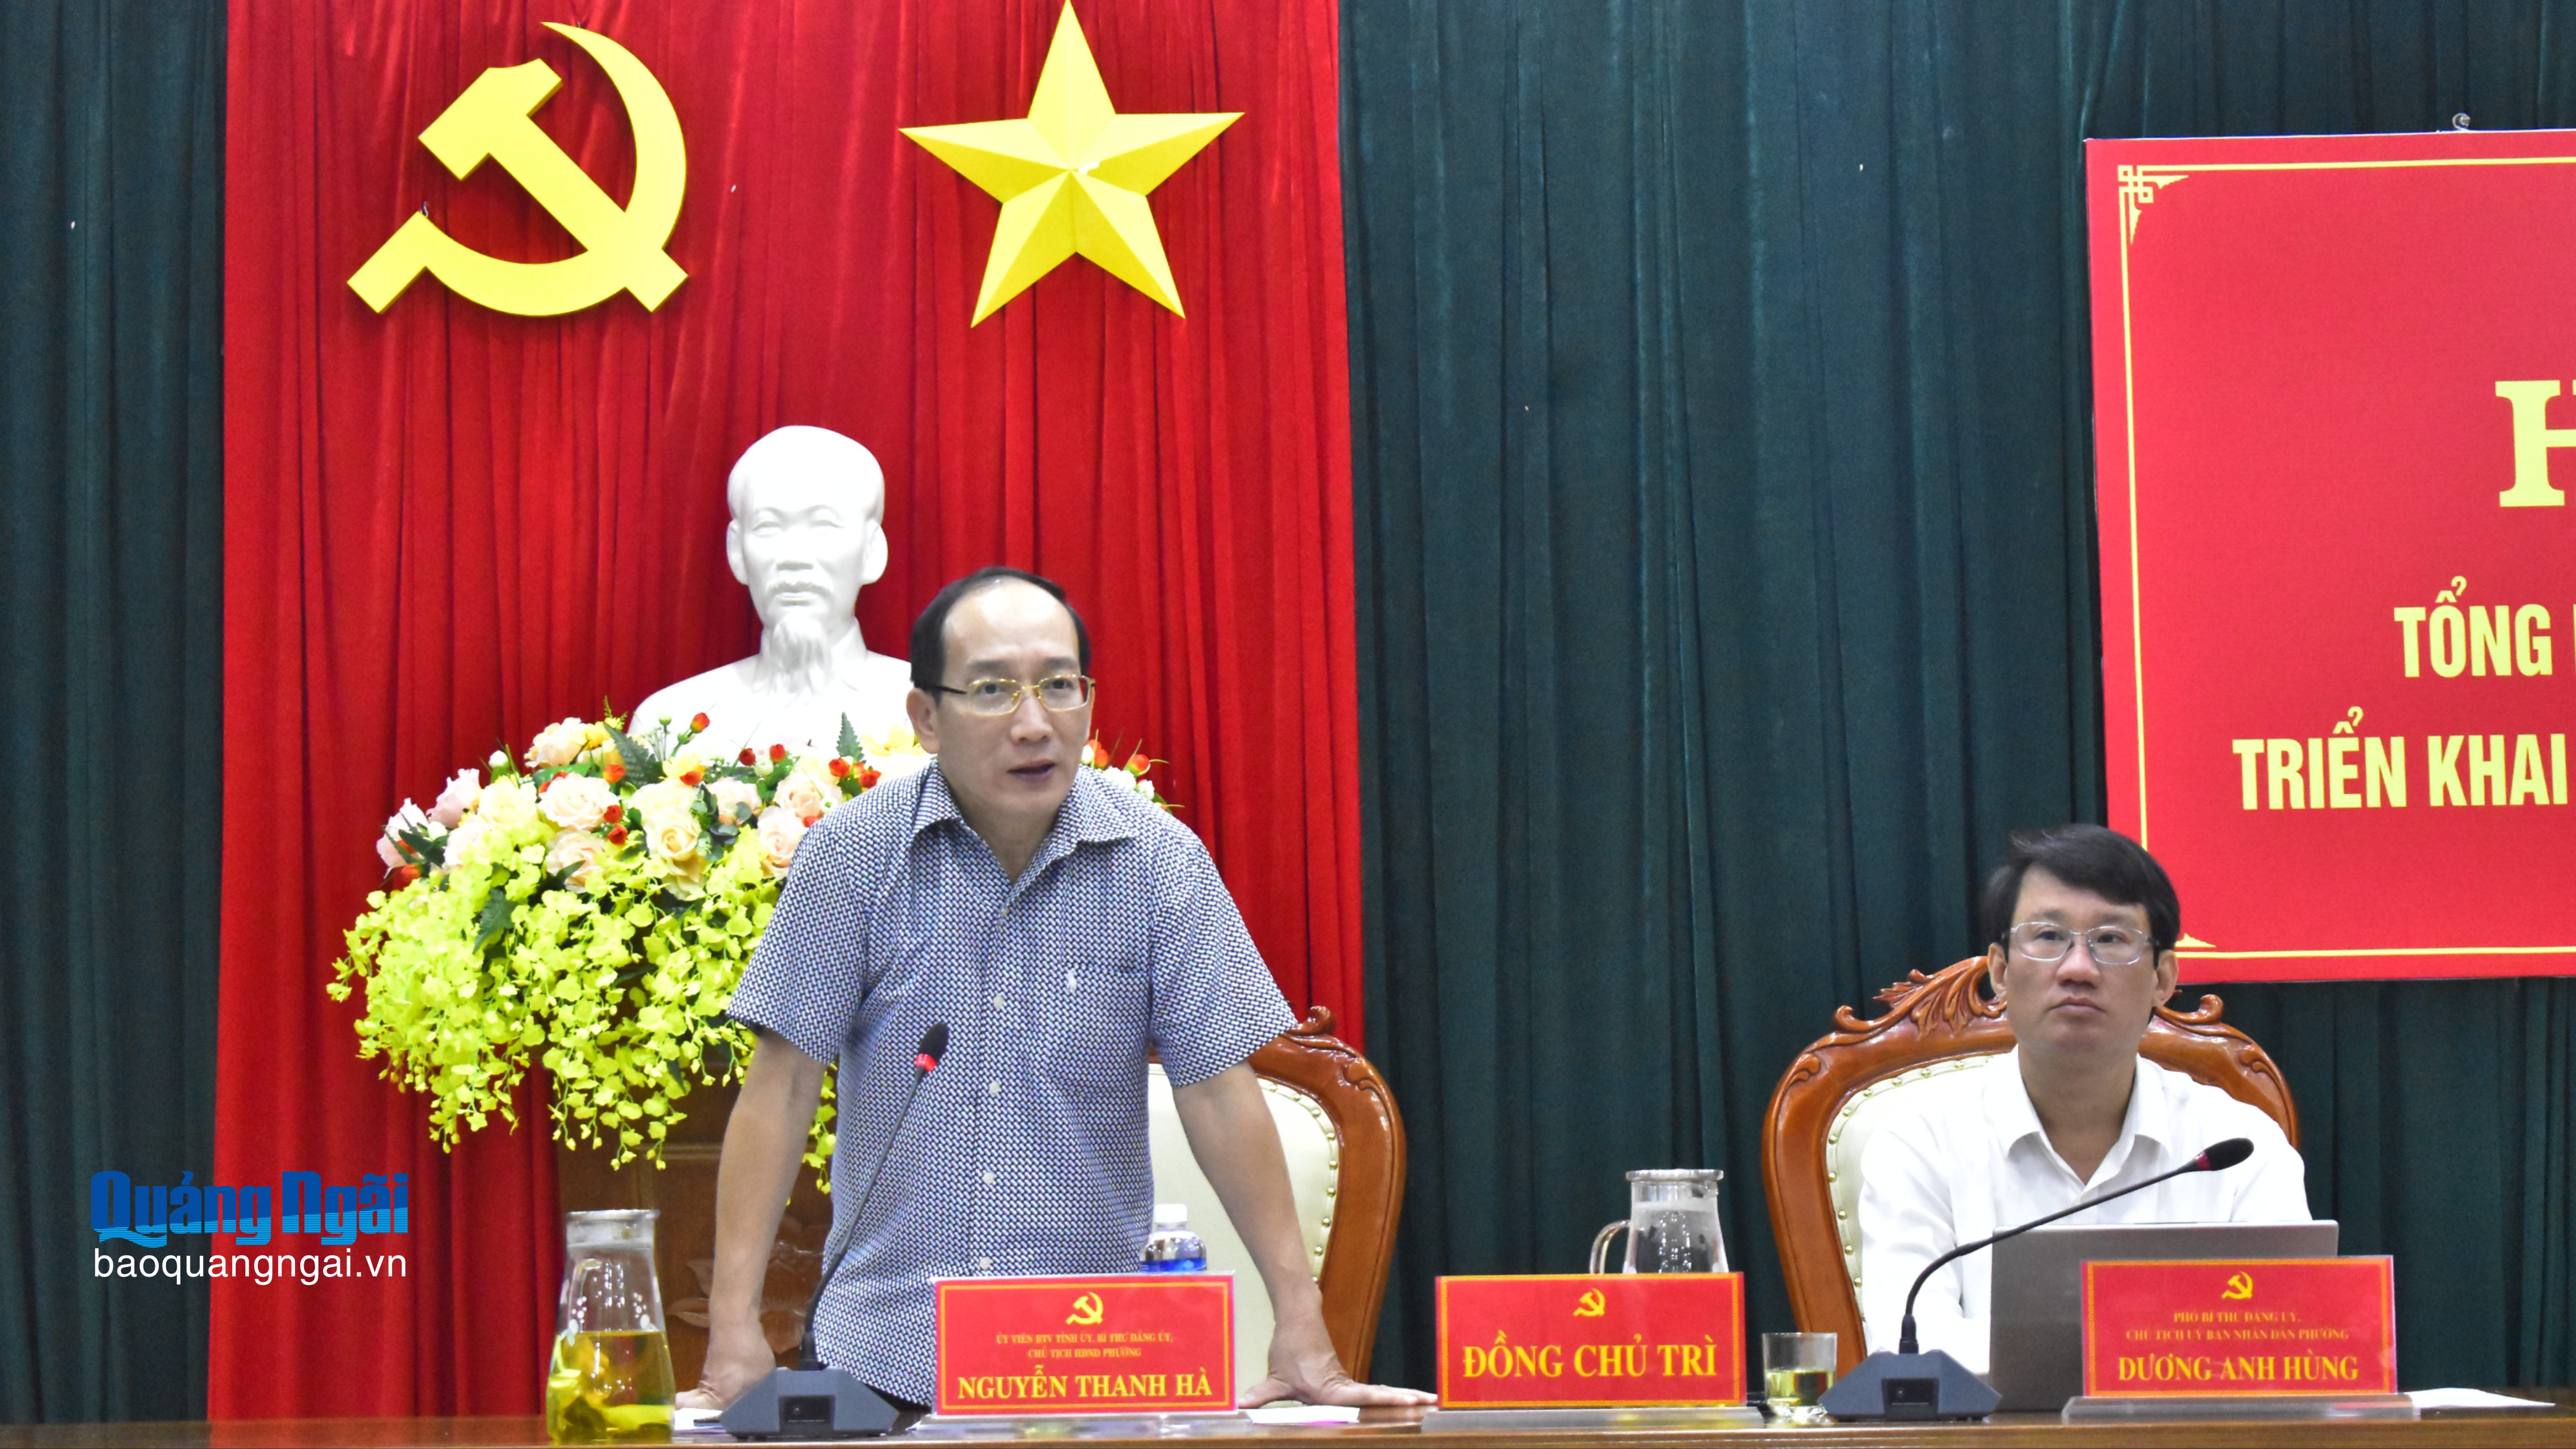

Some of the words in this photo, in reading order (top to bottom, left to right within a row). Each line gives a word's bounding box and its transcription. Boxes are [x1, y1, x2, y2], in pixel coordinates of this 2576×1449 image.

[2394, 575, 2552, 677] TỔNG
[2232, 705, 2407, 810] TRIỂN
[2428, 733, 2568, 807] KHAI
[2174, 1309, 2199, 1322] PHÓ
[1011, 1332, 1033, 1344] VIÊN
[1036, 1334, 1053, 1343] BTV
[1055, 1331, 1078, 1343] TỈNH
[1109, 1331, 1129, 1343] THƯ
[2126, 1327, 2149, 1340] CHỦ
[2156, 1330, 2184, 1342] TỊCH
[2206, 1330, 2231, 1340] BAN
[2234, 1327, 2268, 1340] NHÂN
[2271, 1327, 2296, 1340] DÂN
[2299, 1327, 2349, 1340] PHƯỜNG
[1027, 1345, 1047, 1358] CHỦ
[1050, 1349, 1072, 1359] TỊCH
[1074, 1348, 1101, 1358] HĐND
[1103, 1346, 1142, 1358] PHƯỜNG
[1463, 1330, 1564, 1377] ĐỒNG
[1574, 1334, 1647, 1377] CHỦ
[1657, 1334, 1717, 1376] TRÌ
[2118, 1353, 2212, 1381] DƯƠNG
[2220, 1357, 2276, 1380] ANH
[2284, 1349, 2358, 1380] HÙNG
[958, 1364, 1068, 1399] NGUYỄN
[1075, 1374, 1166, 1397] THANH
[1175, 1367, 1212, 1396] HÀ
